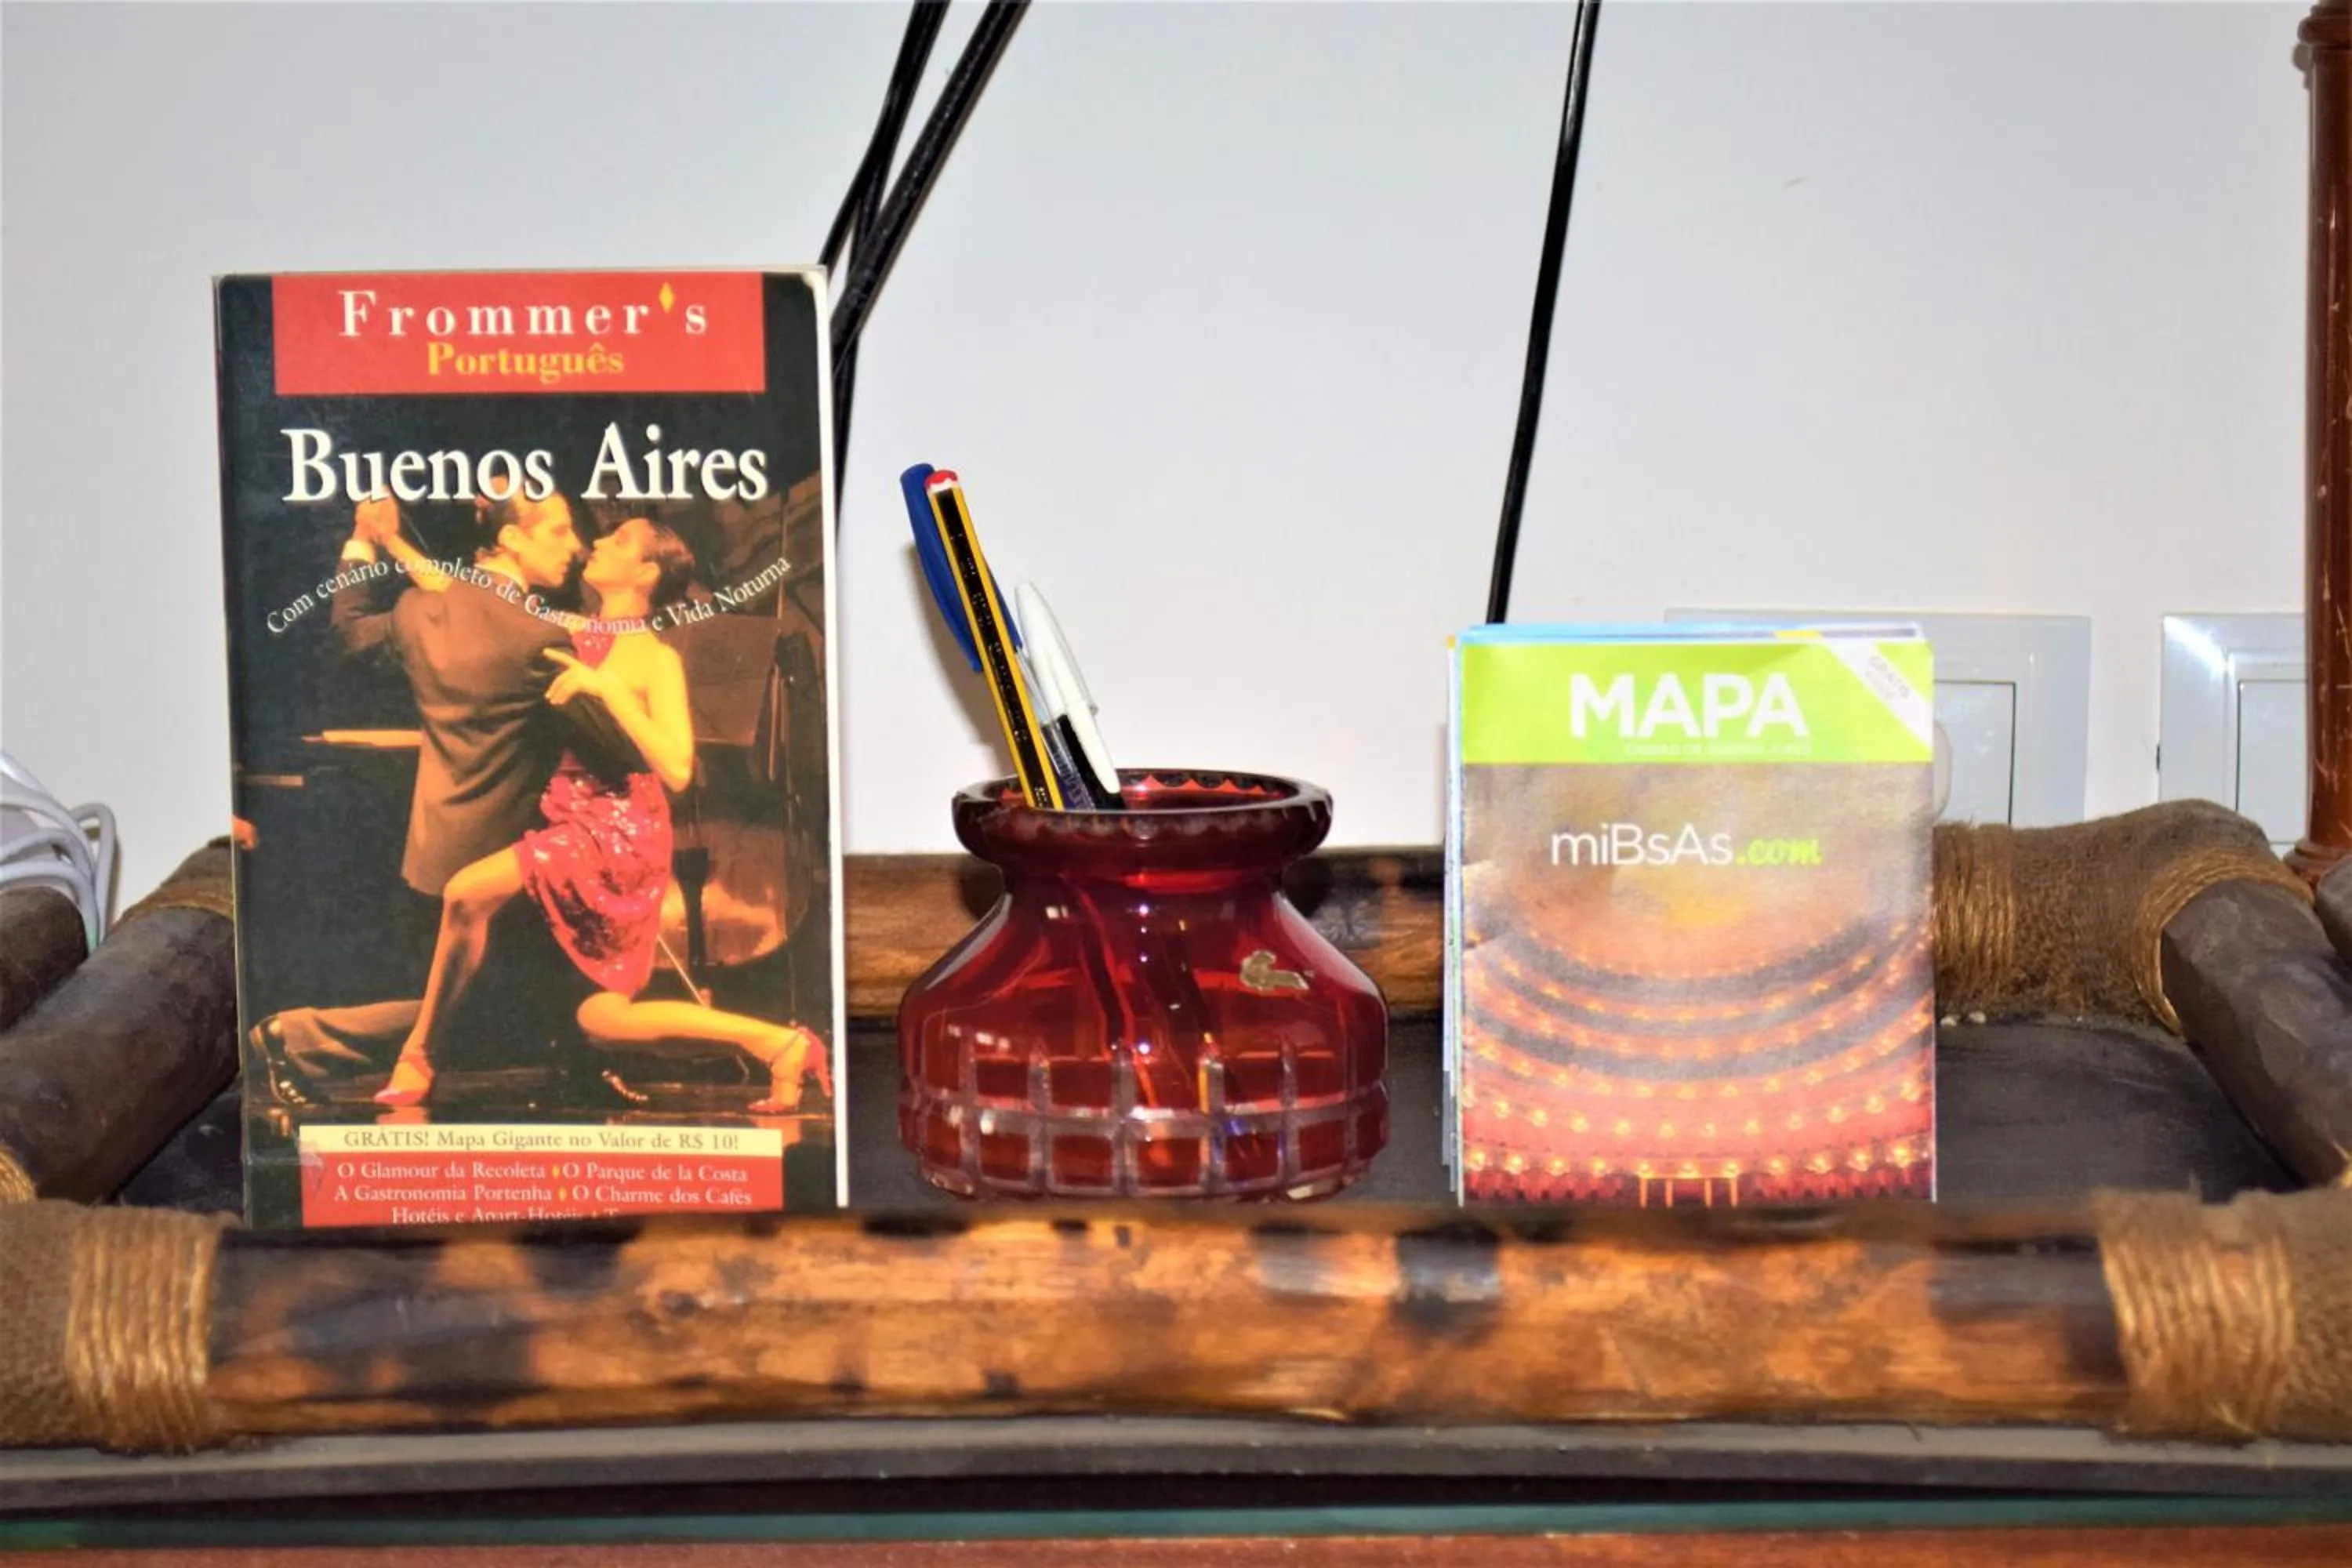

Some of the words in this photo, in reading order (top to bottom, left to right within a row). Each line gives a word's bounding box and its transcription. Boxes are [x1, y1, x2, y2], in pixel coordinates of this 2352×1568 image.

[338, 281, 706, 338] Frommer's
[426, 341, 625, 384] Português
[280, 428, 555, 504] Buenos
[580, 422, 769, 501] Aires
[266, 590, 315, 634] Com
[315, 559, 390, 600] cenário
[394, 557, 492, 590] completo
[495, 578, 521, 605] de
[524, 593, 648, 637] Gastronomia
[651, 615, 665, 633] e
[665, 600, 715, 628] Vida
[711, 554, 793, 615] Noturna
[1568, 673, 1809, 739] MAPA
[436, 1131, 486, 1150] Mapa
[492, 1131, 563, 1150] Gigante
[568, 1136, 592, 1147] no
[597, 1132, 644, 1148] Valor
[651, 1133, 673, 1149] de
[712, 1134, 740, 1150] 10!
[336, 1163, 354, 1178] O
[361, 1163, 438, 1179] Glamour
[444, 1162, 465, 1178] da
[472, 1162, 546, 1179] Recoleta
[562, 1162, 579, 1178] O
[586, 1162, 646, 1184] Parque
[651, 1163, 672, 1181] de
[677, 1164, 693, 1181] la
[698, 1165, 748, 1182] Costa
[334, 1185, 349, 1201] A
[354, 1185, 466, 1202] Gastronomia
[474, 1185, 552, 1202] Portenha
[572, 1185, 590, 1202] O
[595, 1185, 664, 1203] Charme
[669, 1186, 701, 1204] dos
[706, 1186, 753, 1205] Cafés
[392, 1206, 450, 1225] Hotéis
[455, 1213, 465, 1223] e
